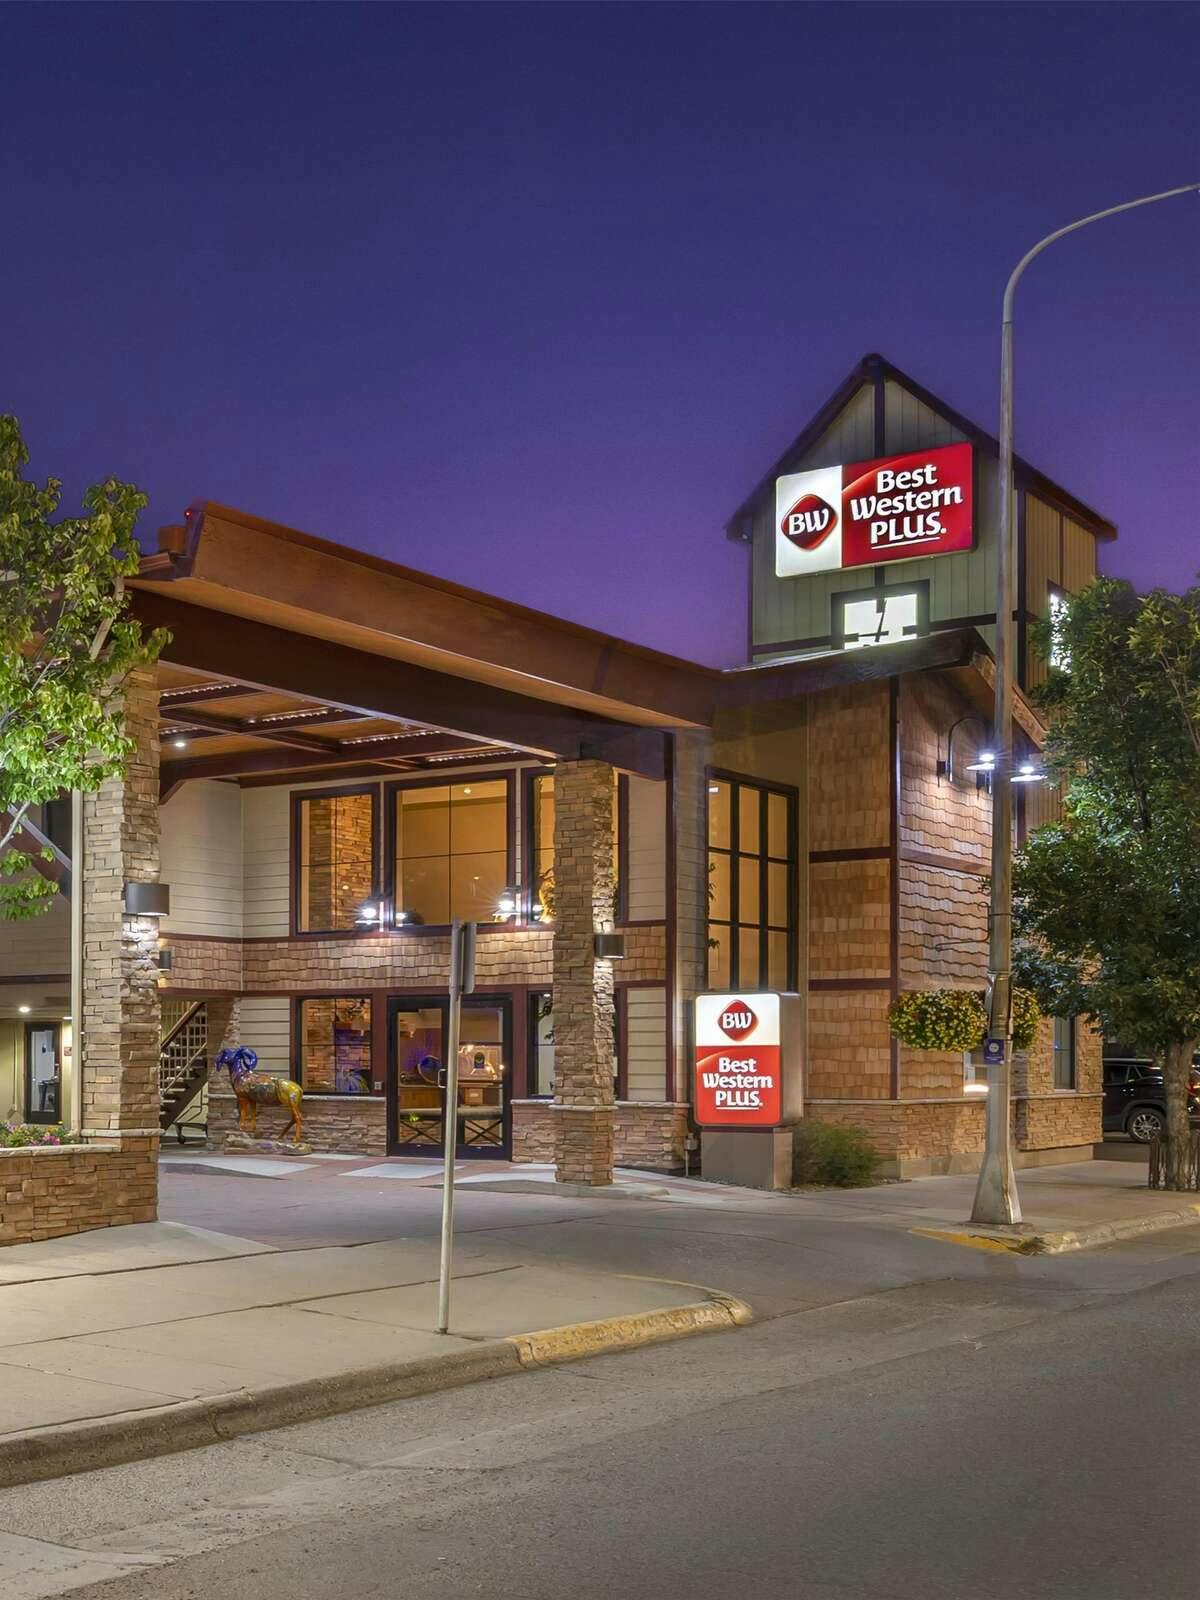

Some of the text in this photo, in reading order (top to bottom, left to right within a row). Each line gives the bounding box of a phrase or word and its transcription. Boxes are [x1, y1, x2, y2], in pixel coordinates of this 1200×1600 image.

[877, 464, 938, 494] Best
[850, 486, 963, 521] Western
[788, 507, 829, 536] BW
[722, 1012, 752, 1029] BW
[718, 1057, 757, 1073] Best
[702, 1072, 773, 1089] Western
